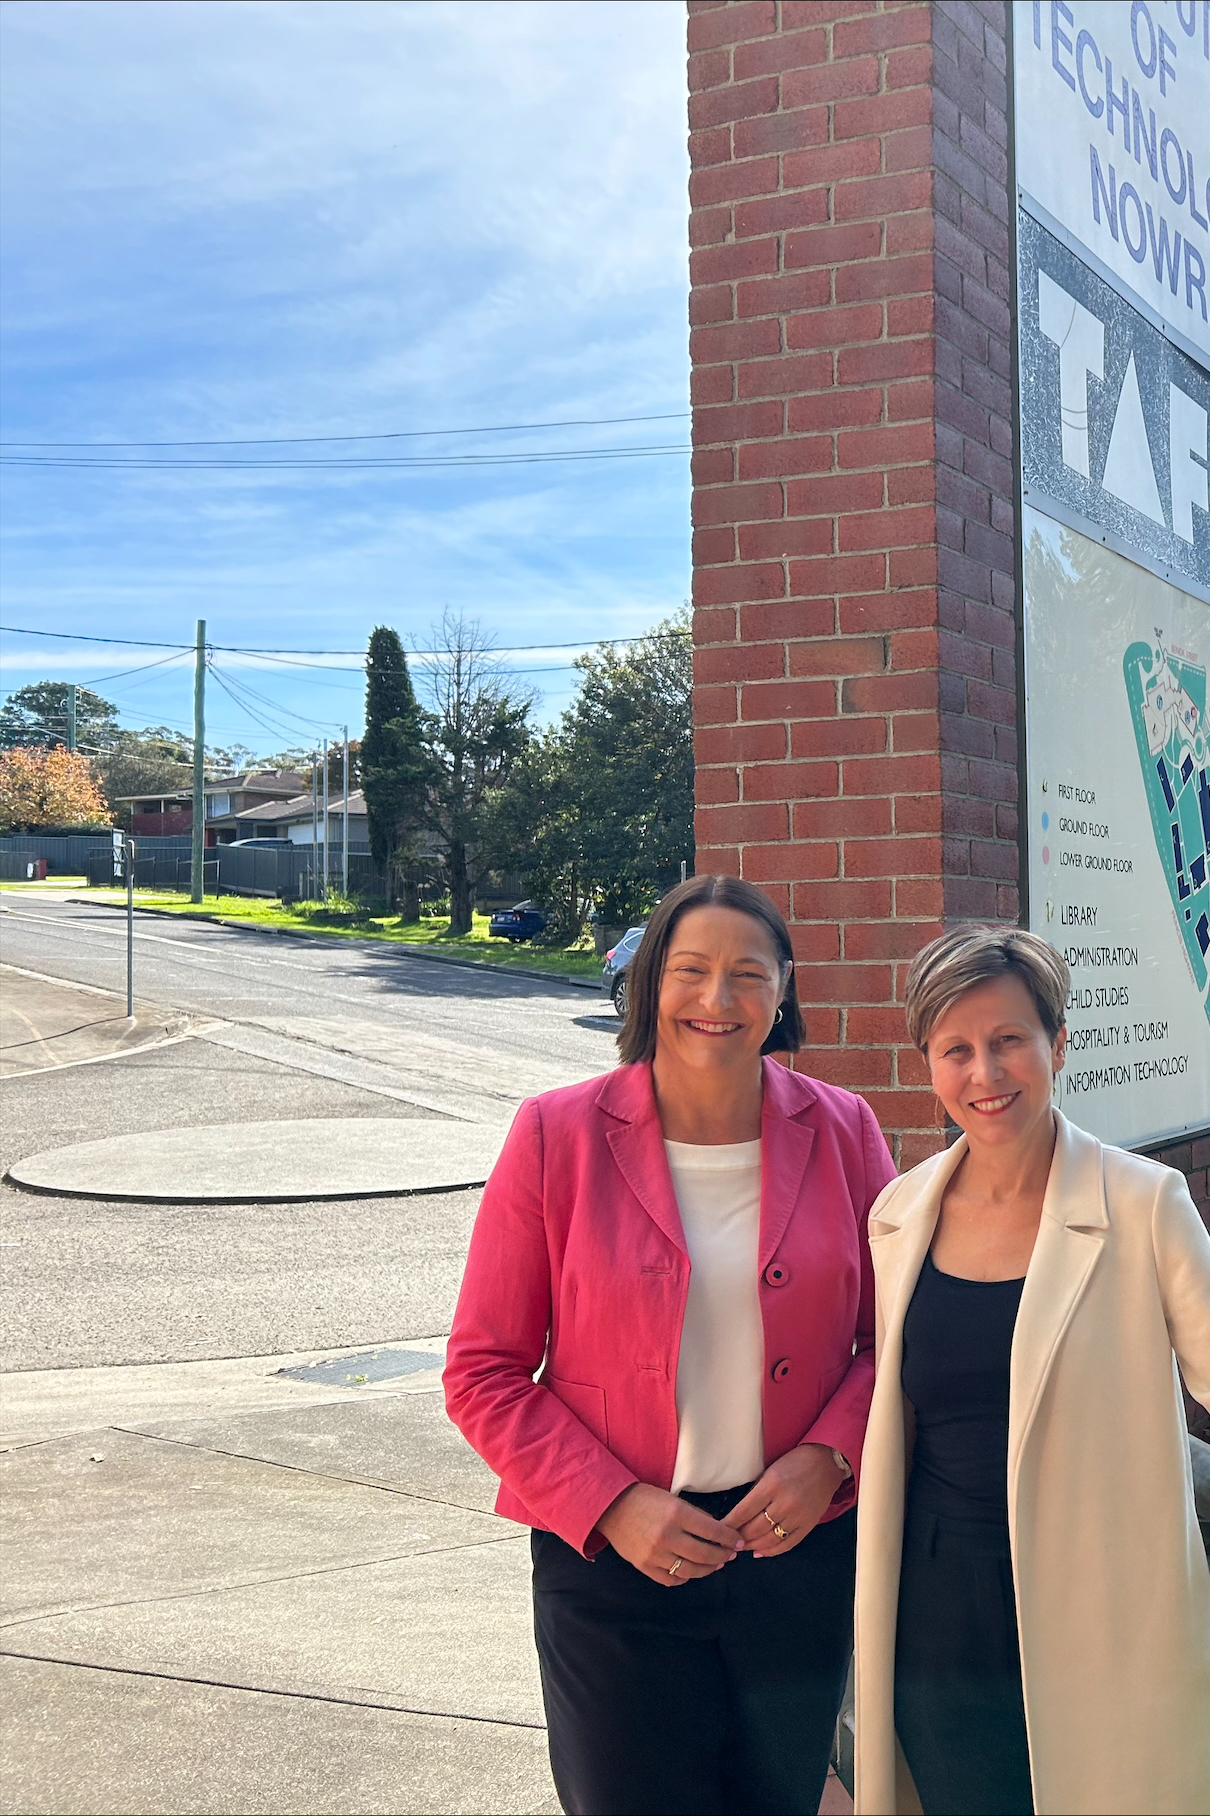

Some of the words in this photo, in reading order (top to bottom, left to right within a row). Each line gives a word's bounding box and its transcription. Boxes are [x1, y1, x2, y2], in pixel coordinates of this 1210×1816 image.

[1130, 1, 1177, 98] OF
[1058, 784, 1073, 800] FIRST
[1075, 788, 1096, 805] FLOOR
[1059, 818, 1087, 834] GROUND
[1089, 823, 1109, 838] FLOOR
[1059, 851, 1083, 868] LOWER
[1085, 855, 1112, 870] GROUND
[1113, 859, 1133, 873] FLOOR
[1061, 905, 1097, 926] LIBRARY
[1064, 947, 1138, 967] ADMINISTRATION
[1095, 986, 1129, 1008] STUDIES
[1066, 1026, 1120, 1051] HOSPITALITY
[1123, 1025, 1130, 1044] &
[1133, 1021, 1168, 1042] TOURISM
[1066, 1064, 1131, 1094] INFORMATION
[1133, 1055, 1189, 1082] TECHNOLOGY
